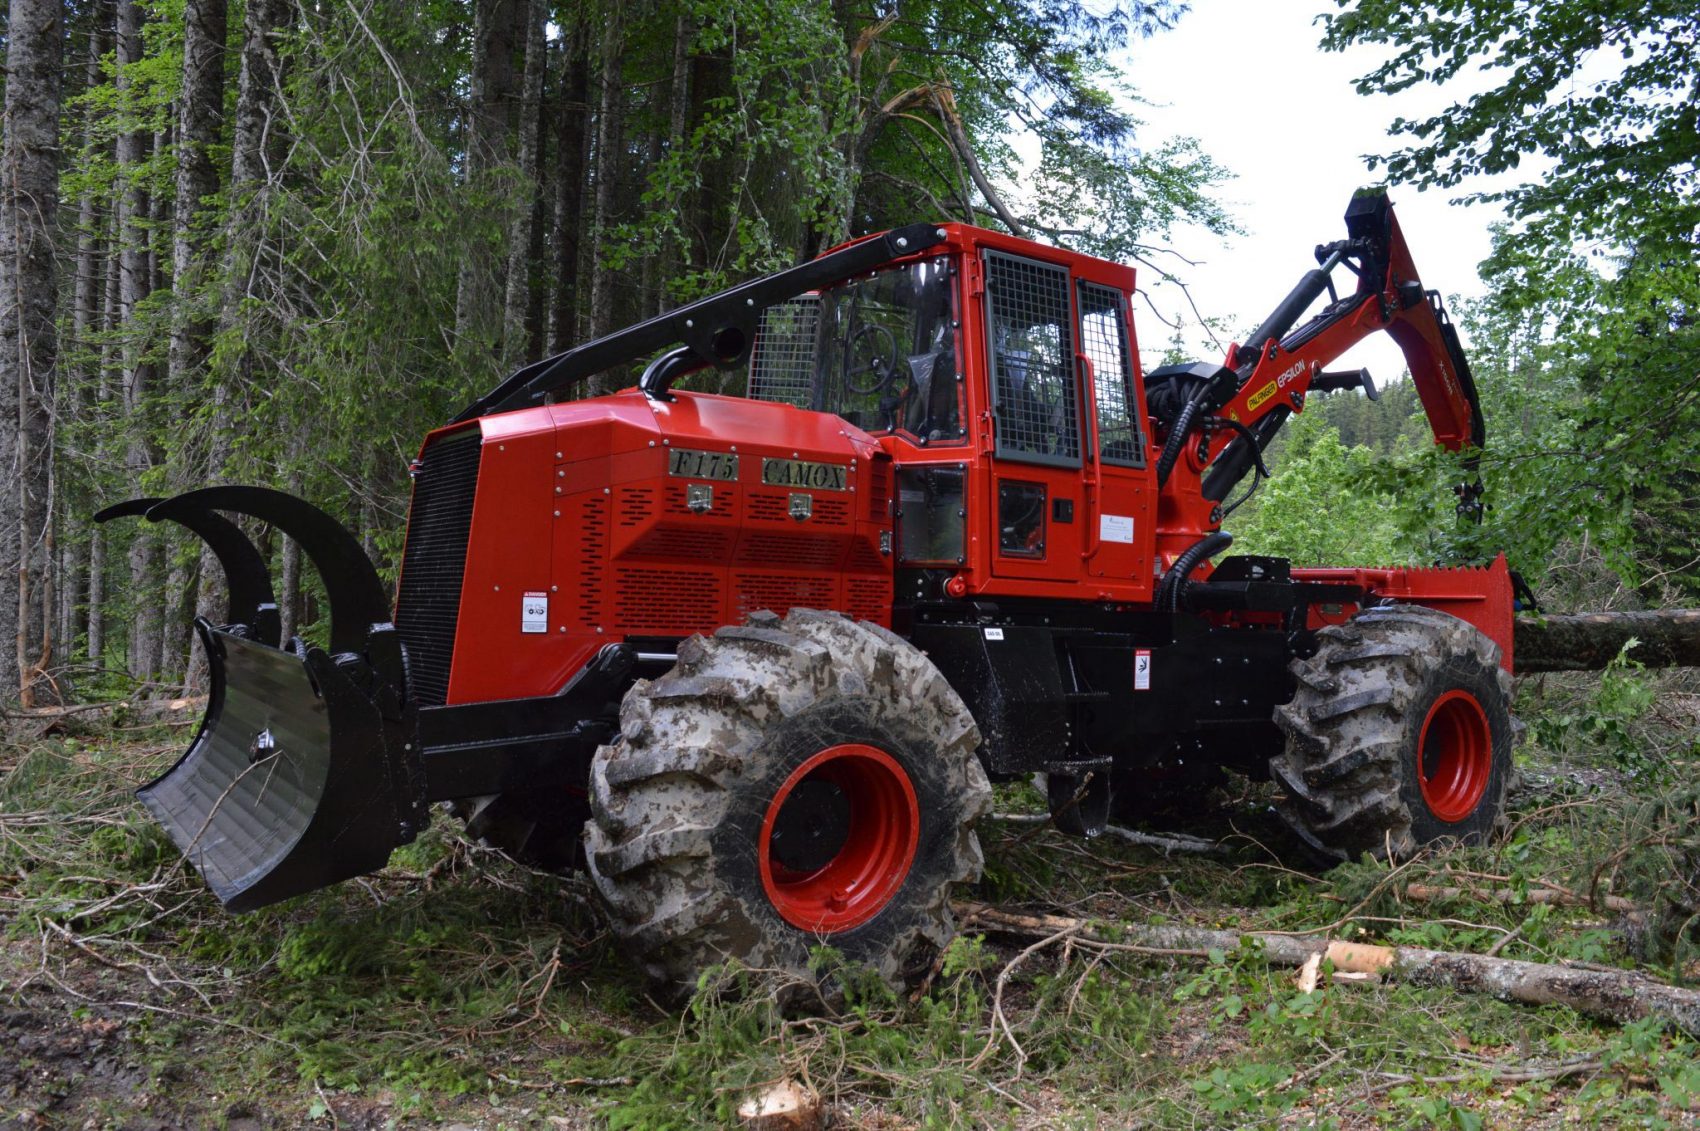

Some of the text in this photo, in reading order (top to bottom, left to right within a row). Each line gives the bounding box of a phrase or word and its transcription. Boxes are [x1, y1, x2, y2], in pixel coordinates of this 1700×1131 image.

[1248, 359, 1306, 409] PALFINGER EPSILON
[674, 451, 735, 479] F175
[764, 459, 845, 489] CAMOX
